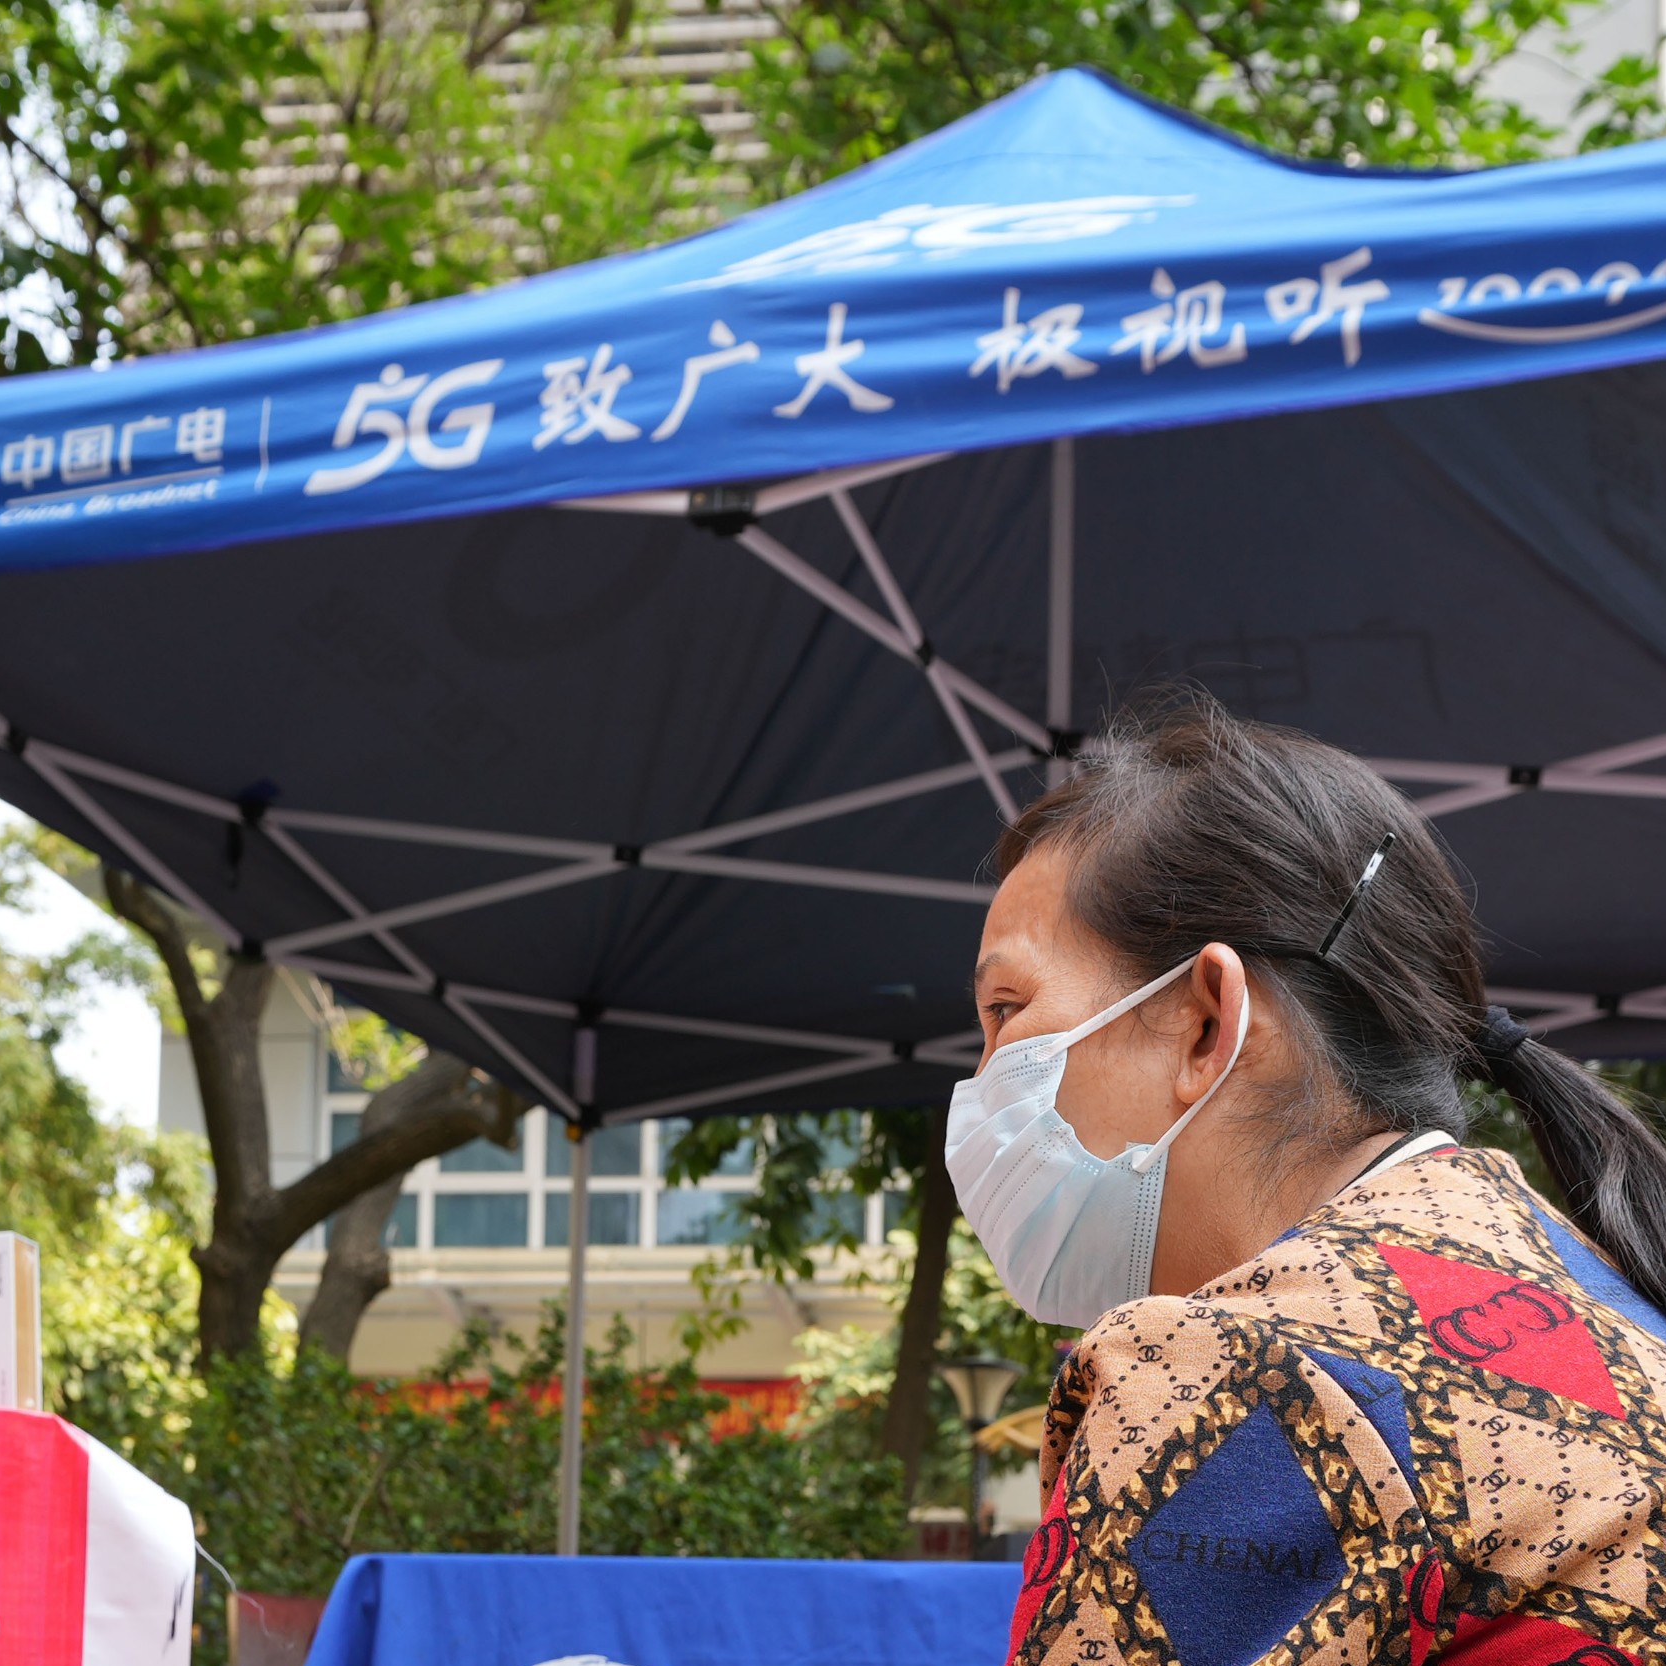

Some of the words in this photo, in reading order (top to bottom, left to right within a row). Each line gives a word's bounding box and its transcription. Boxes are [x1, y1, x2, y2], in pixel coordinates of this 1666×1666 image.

[1, 406, 227, 488] 中国广电
[303, 359, 504, 496] 5G
[531, 302, 895, 451] 致广大
[969, 246, 1391, 395] 极视听
[1137, 1530, 1335, 1582] CHENAL
